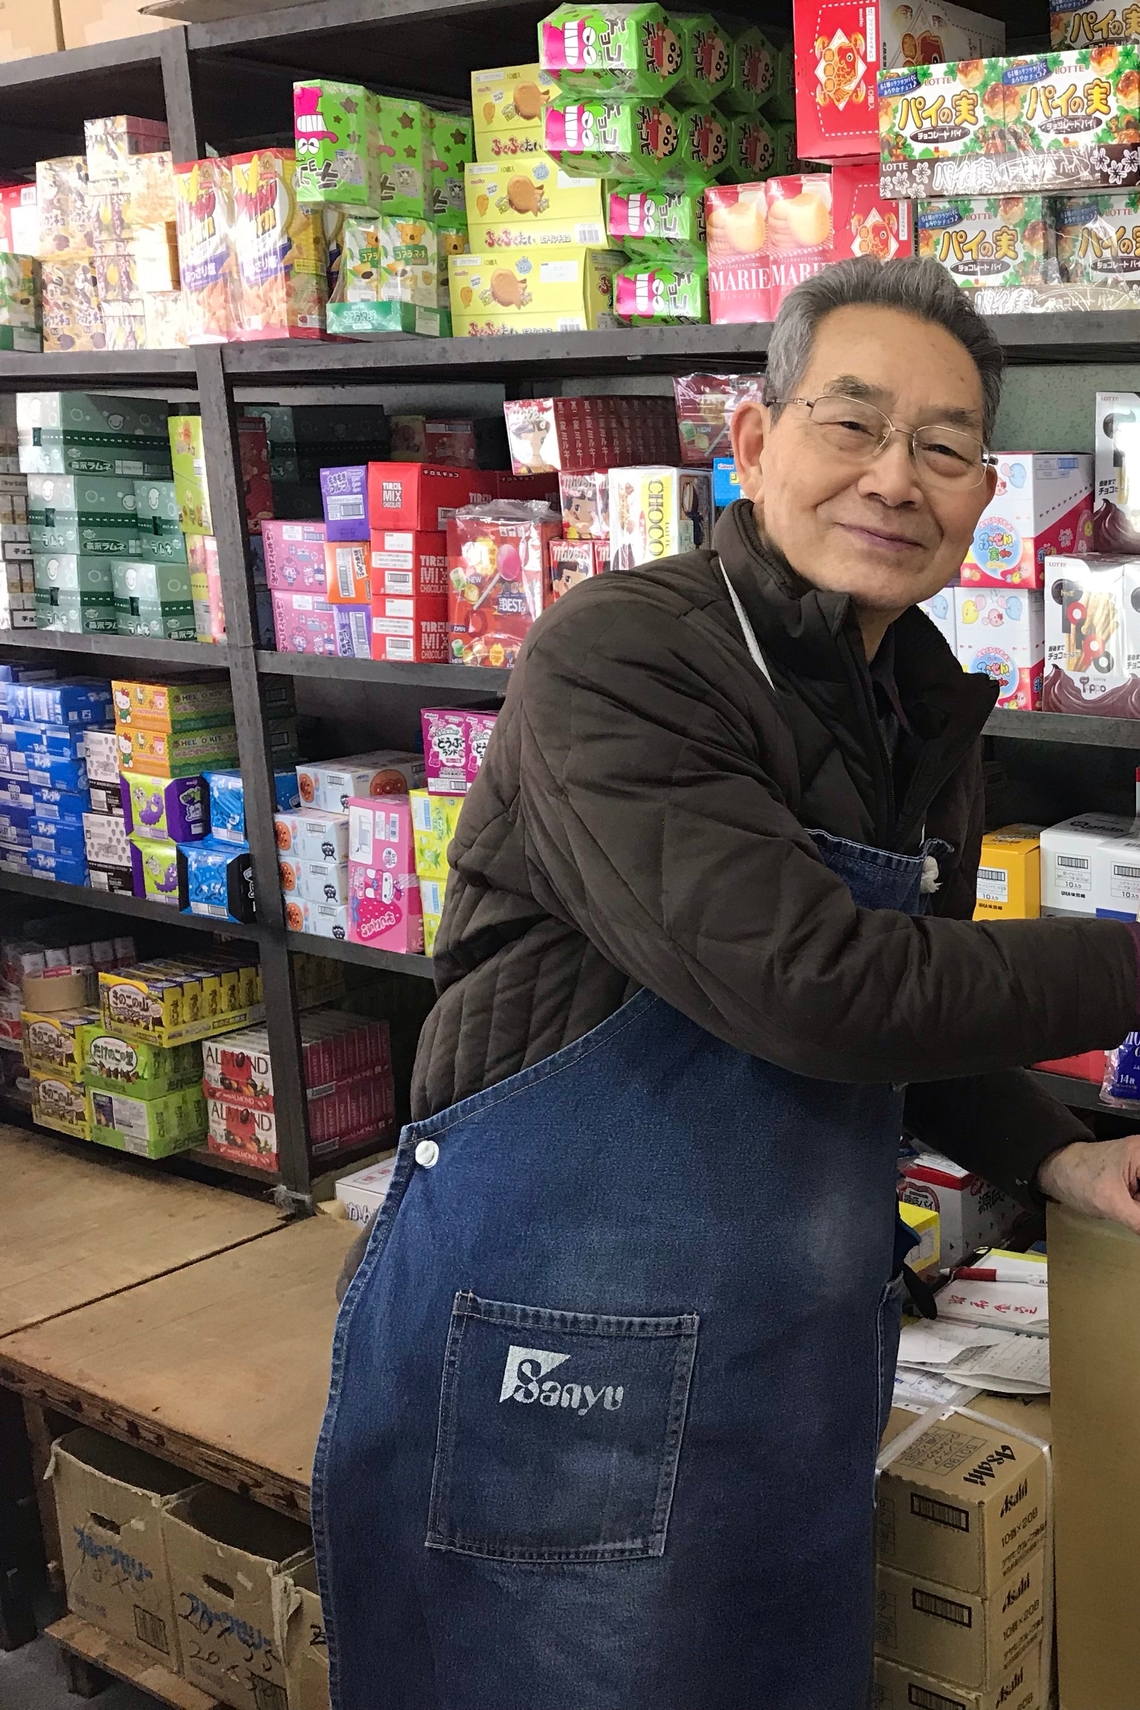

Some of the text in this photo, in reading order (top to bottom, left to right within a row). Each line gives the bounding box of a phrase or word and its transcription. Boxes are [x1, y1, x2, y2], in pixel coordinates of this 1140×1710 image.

[1054, 64, 1085, 75] LOTTE
[924, 76, 952, 87] LOTTE
[1026, 78, 1111, 121] パイの実
[898, 90, 979, 131] パイの実
[882, 162, 909, 172] LOTTE
[965, 212, 993, 222] LOTTE
[1105, 207, 1134, 217] LOTTE
[485, 229, 535, 247] ぷくぷくたい
[939, 226, 1019, 262] パイの実
[710, 267, 771, 292] MARIE
[383, 491, 402, 502] MIX
[647, 479, 665, 557] CHOCO
[503, 599, 523, 612] BEST
[1065, 881, 1082, 889] 10入り
[1121, 891, 1139, 899] 10入り
[111, 991, 150, 1013] きのこの山
[512, 1358, 624, 1416] Sanyu
[963, 1443, 1018, 1487] Asahi
[1000, 1478, 1028, 1518] Asahi
[1002, 1572, 1031, 1614] Asahi
